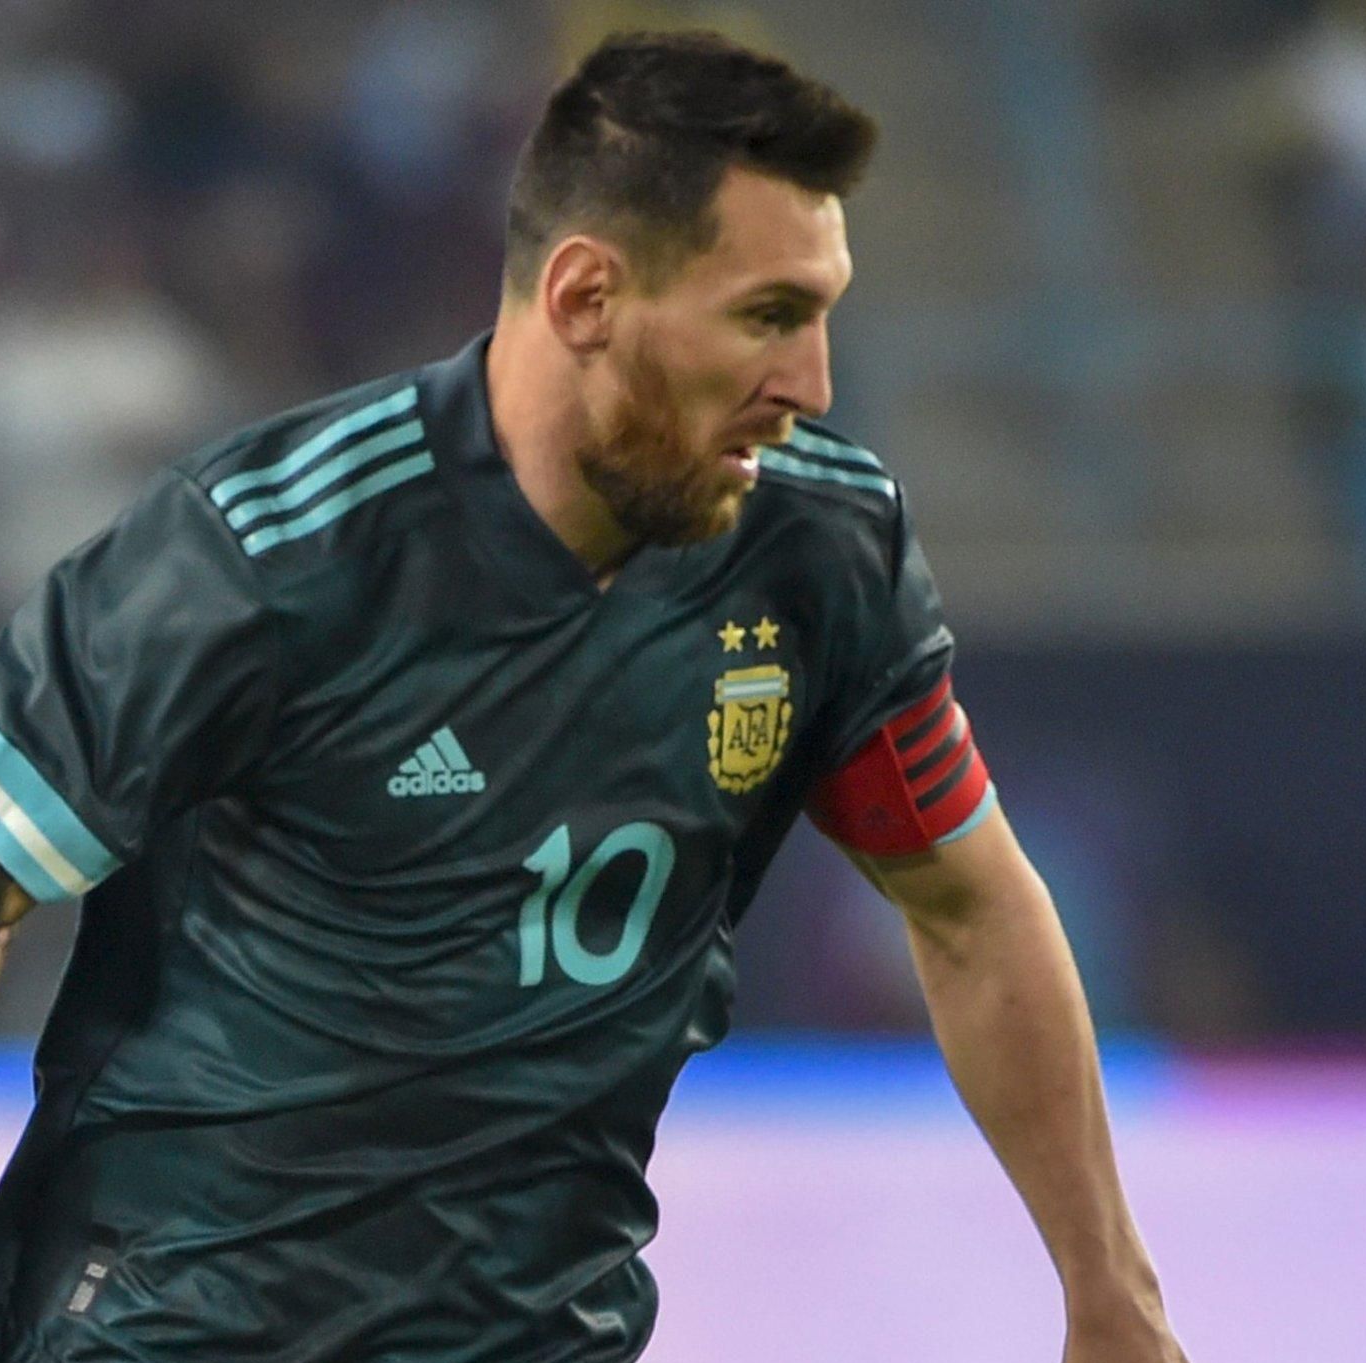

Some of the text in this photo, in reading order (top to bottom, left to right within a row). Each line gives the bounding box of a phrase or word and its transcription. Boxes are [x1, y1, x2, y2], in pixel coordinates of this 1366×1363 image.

[726, 702, 771, 757] AFA
[387, 769, 486, 798] adidas
[519, 821, 676, 987] 10
